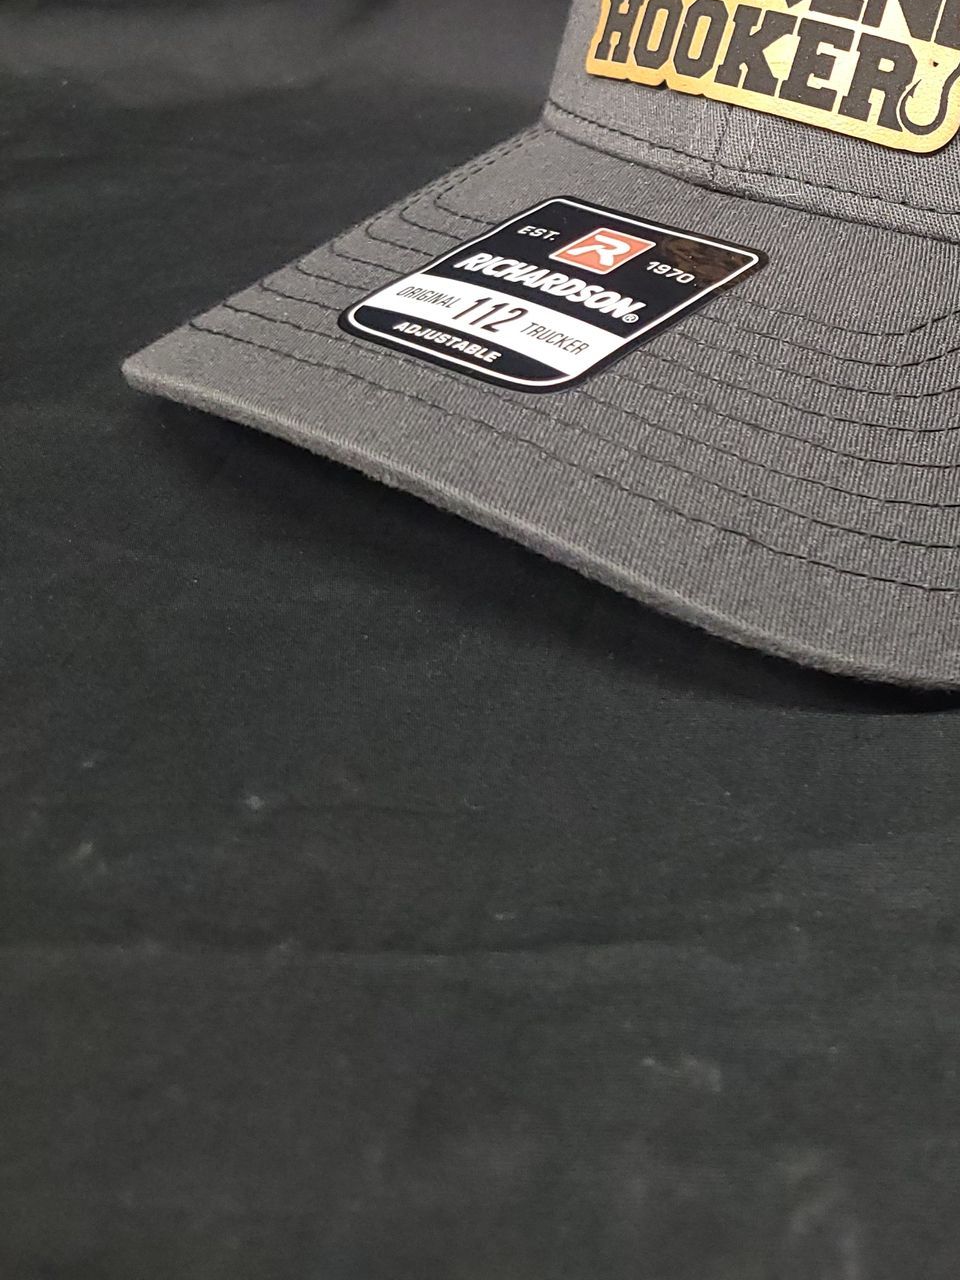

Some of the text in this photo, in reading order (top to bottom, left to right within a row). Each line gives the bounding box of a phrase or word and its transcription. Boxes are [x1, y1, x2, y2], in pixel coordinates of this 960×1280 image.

[517, 225, 559, 241] EST.
[645, 260, 695, 284] 1970
[396, 286, 590, 356] ORIGINAL 112 TRUCKER
[393, 321, 502, 363] ADJUSTABLE
